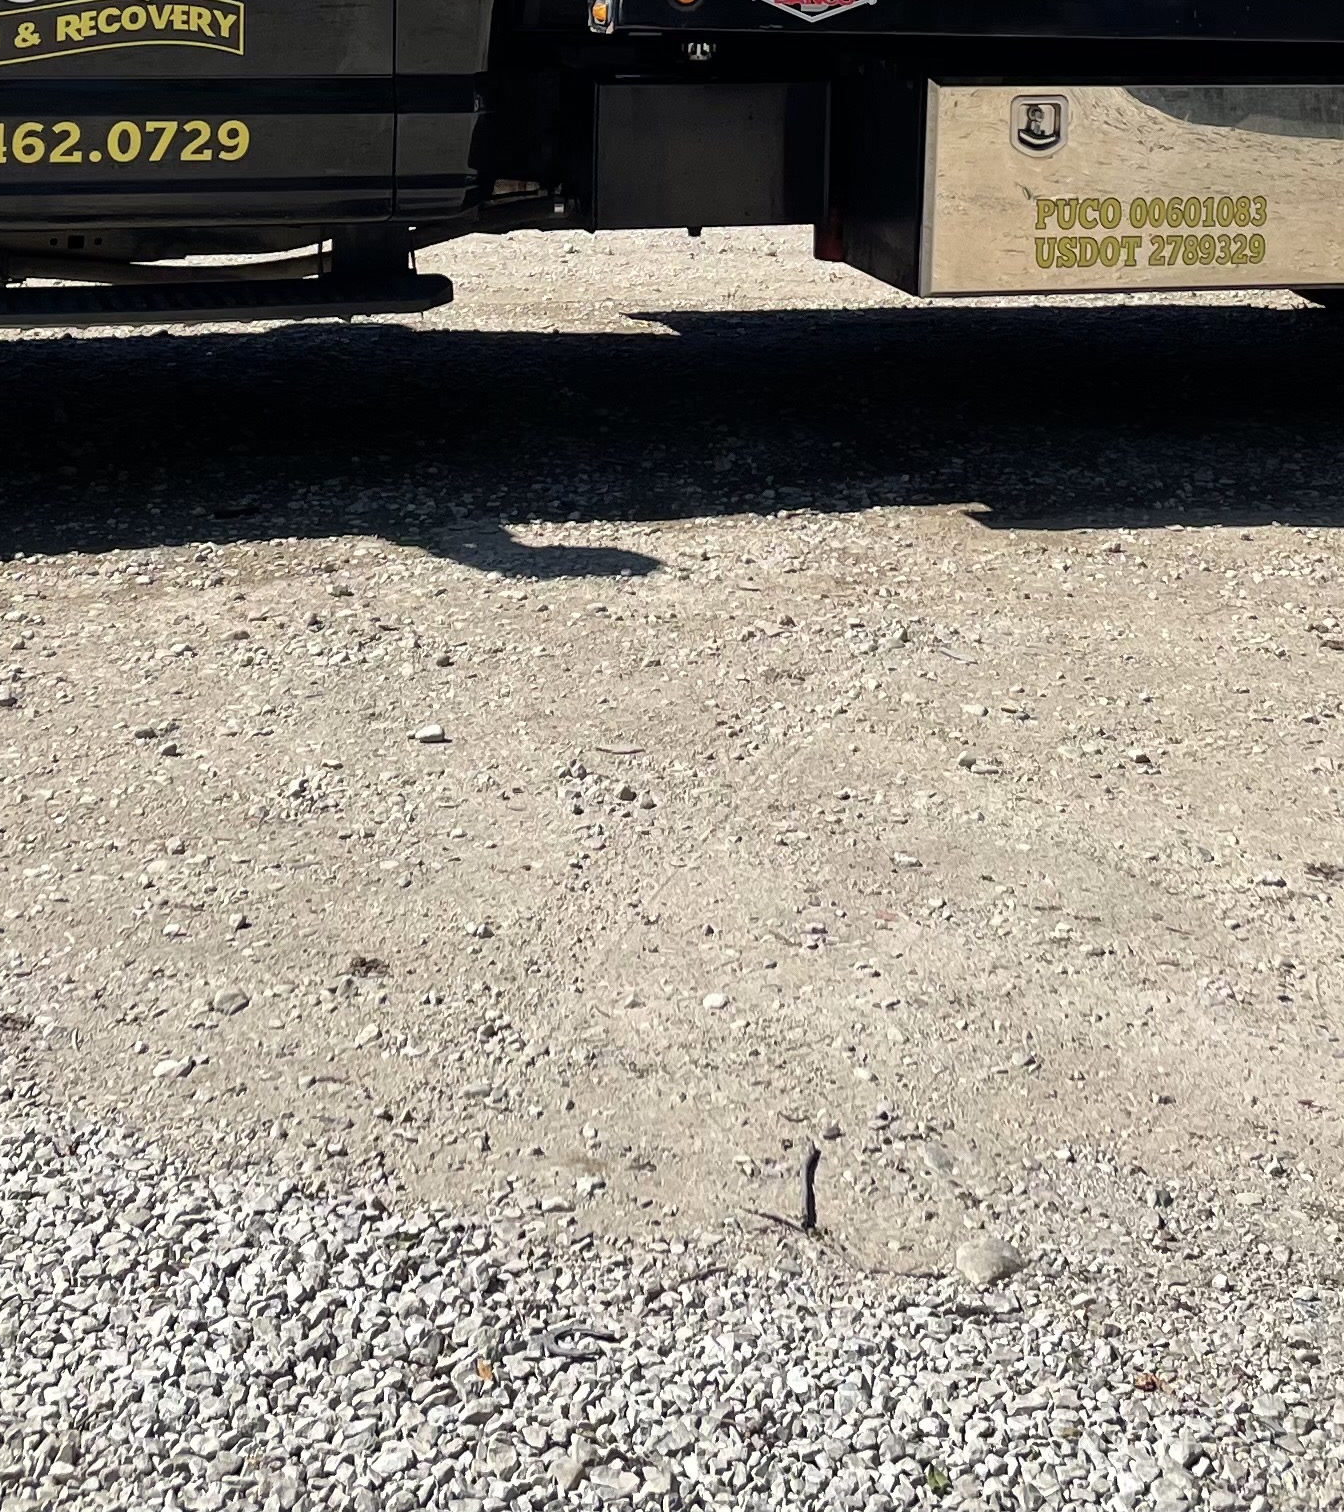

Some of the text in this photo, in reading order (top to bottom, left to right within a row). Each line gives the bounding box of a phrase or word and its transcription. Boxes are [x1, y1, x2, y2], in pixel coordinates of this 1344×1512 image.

[14, 22, 41, 48] &
[56, 3, 238, 42] RECOVERY
[1035, 196, 1267, 230] PUCO 00601083
[1034, 233, 1266, 269] USDOT 2789329
